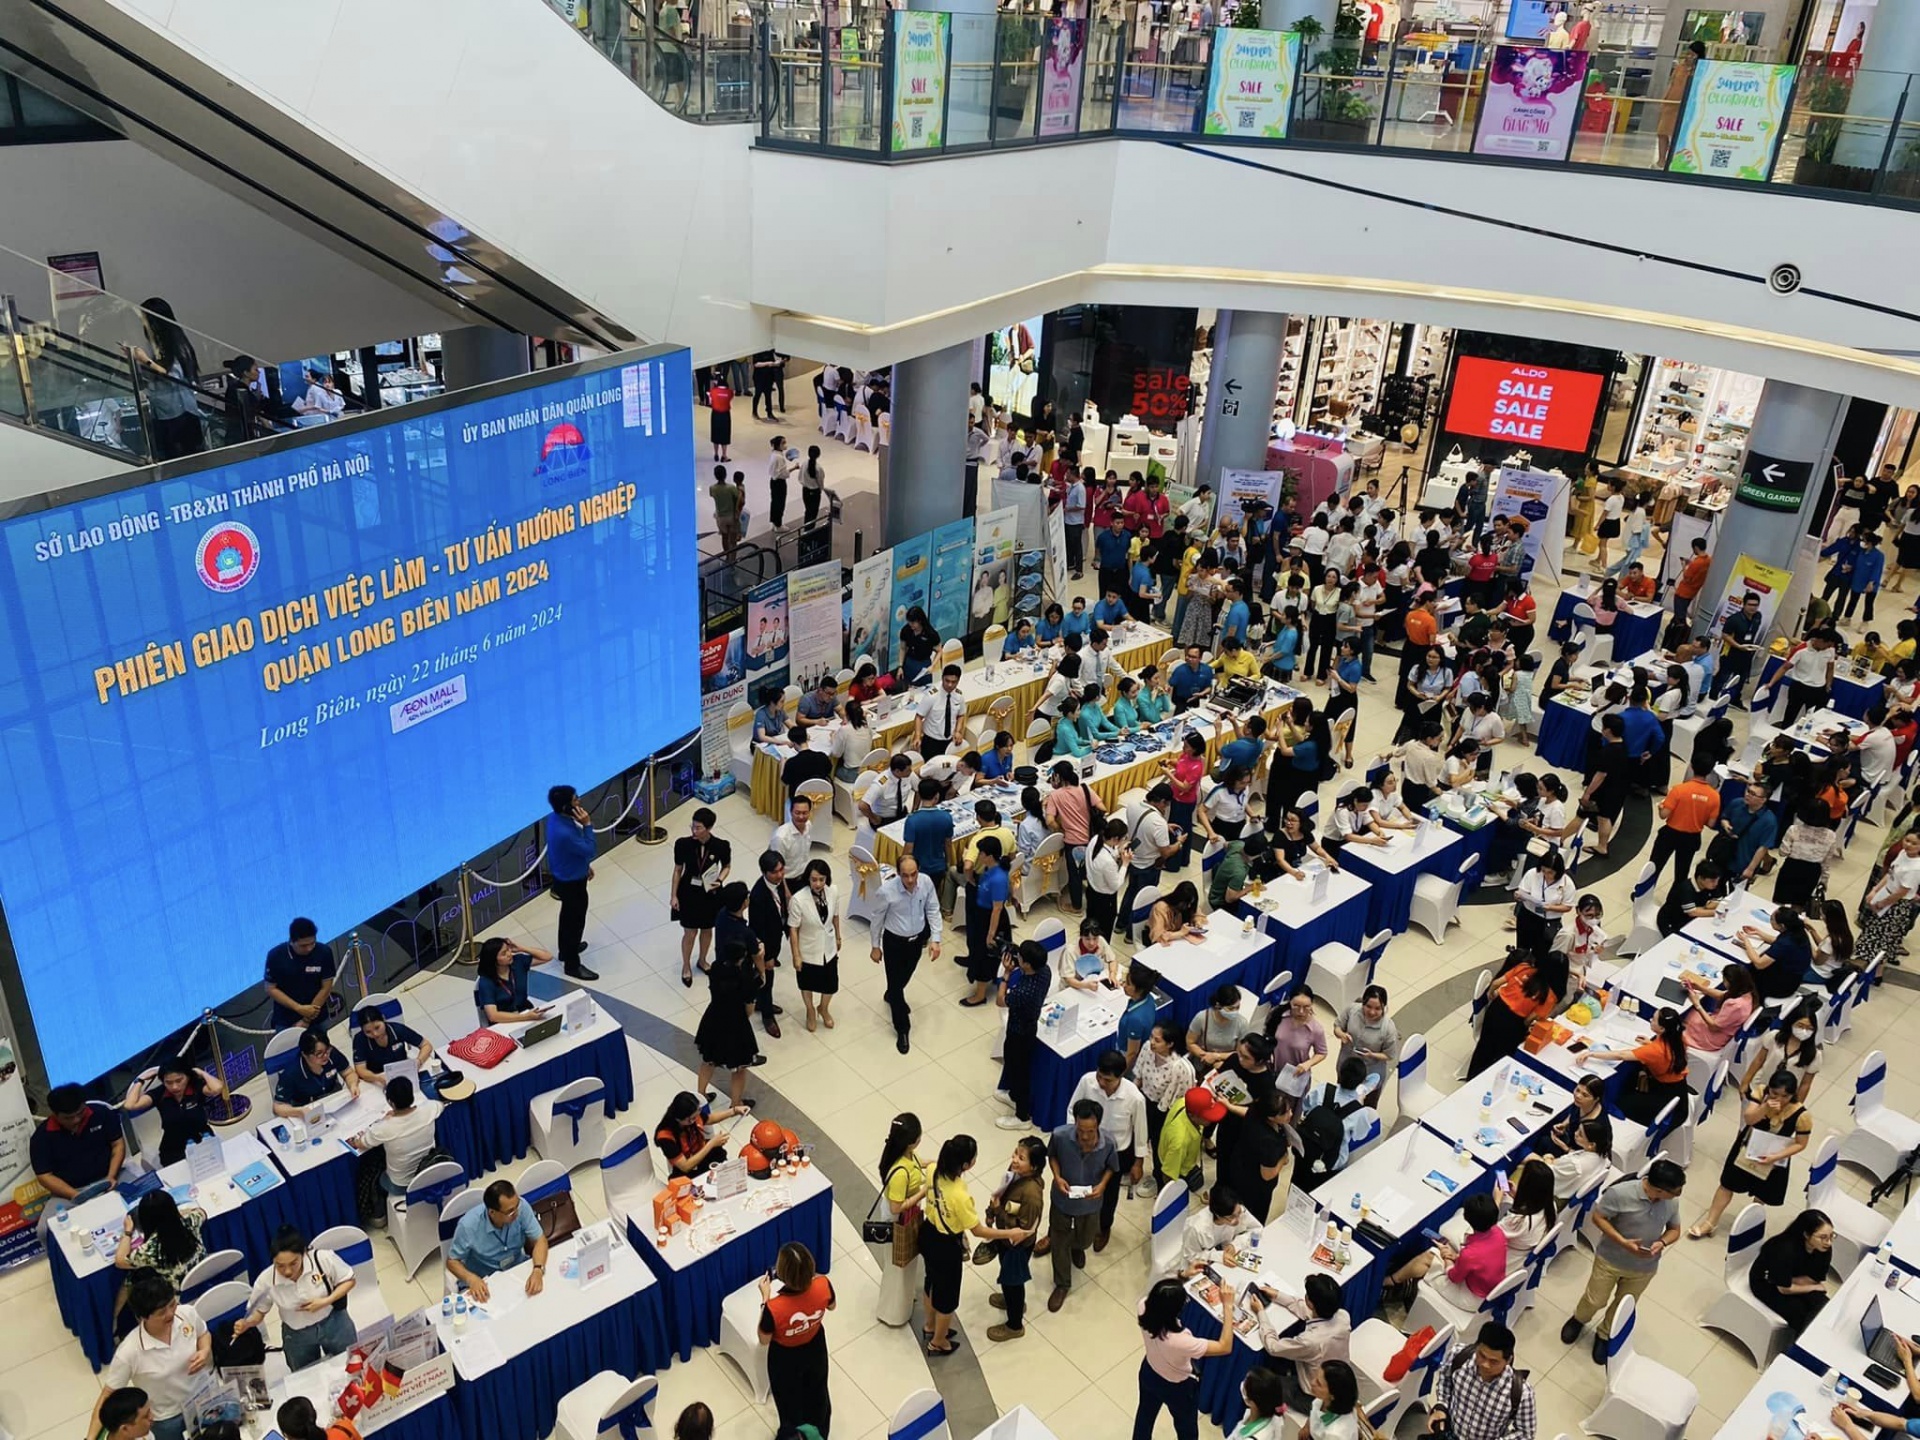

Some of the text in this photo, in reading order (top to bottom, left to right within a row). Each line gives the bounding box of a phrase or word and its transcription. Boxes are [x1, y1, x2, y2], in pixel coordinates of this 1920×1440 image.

[1239, 81, 1262, 94] SALE
[1716, 116, 1744, 132] SALE
[1134, 368, 1189, 391] sale
[1511, 367, 1548, 379] ALDO
[1498, 379, 1553, 401] SALE
[481, 416, 506, 439] BAN
[508, 407, 540, 430] NHÂN
[542, 402, 564, 422] DÂN
[566, 393, 594, 416] QUẬN
[596, 387, 622, 407] LONG
[1131, 392, 1187, 417] 50%
[1494, 399, 1548, 420] SALE
[1490, 418, 1544, 439] SALE
[1743, 485, 1801, 503] GREEN GARDEN
[35, 531, 63, 562] SỞ
[68, 525, 104, 553] LAO
[108, 511, 161, 542] ĐỘNG
[231, 478, 285, 509] THÀNH
[288, 462, 318, 493] PHỐ
[321, 460, 342, 482] HÀ
[344, 453, 370, 478] NỘI
[94, 641, 186, 704] PHIÊN
[192, 617, 254, 669] GIAO
[259, 595, 319, 645] DỊCH
[323, 574, 375, 621] VIỆC
[380, 556, 427, 600] LÀM
[443, 537, 471, 576] TƯ
[473, 518, 512, 566] VẤN
[516, 506, 576, 550] HƯỚNG
[578, 481, 637, 527] NGHIỆP
[262, 559, 550, 693] QUẬN LONG BIÊN NĂM 2024
[260, 602, 564, 750] Long Biên, ngày 22 tháng 6 năm 2024
[429, 683, 459, 705] MALL
